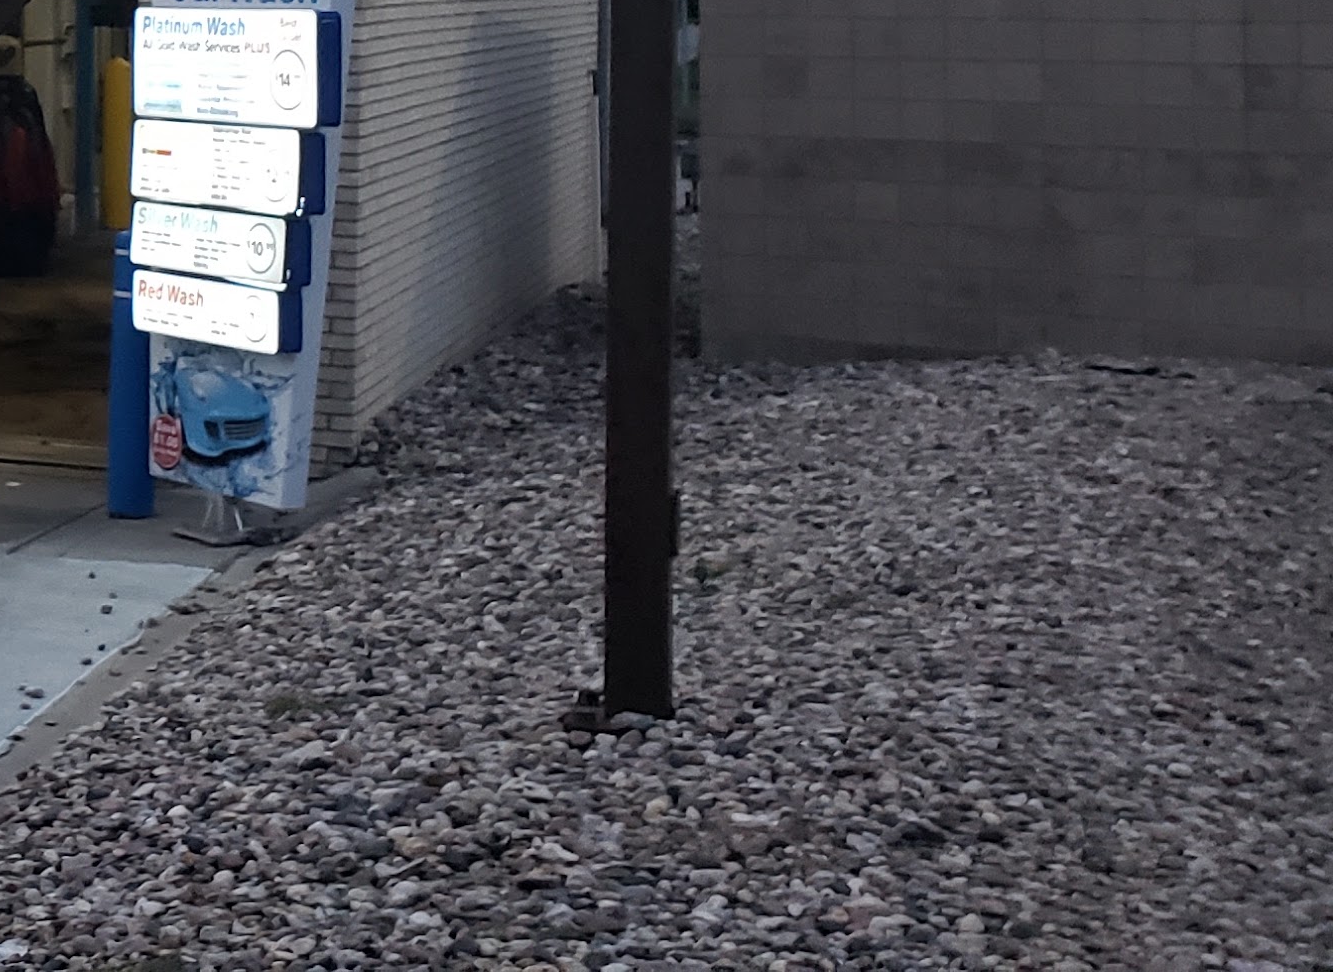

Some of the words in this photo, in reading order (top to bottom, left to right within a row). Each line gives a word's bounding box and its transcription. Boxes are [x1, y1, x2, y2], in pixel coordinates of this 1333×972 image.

[143, 15, 203, 34] Platinum
[207, 17, 245, 36] Wash
[138, 279, 163, 299] Red
[167, 284, 204, 307] Wash
